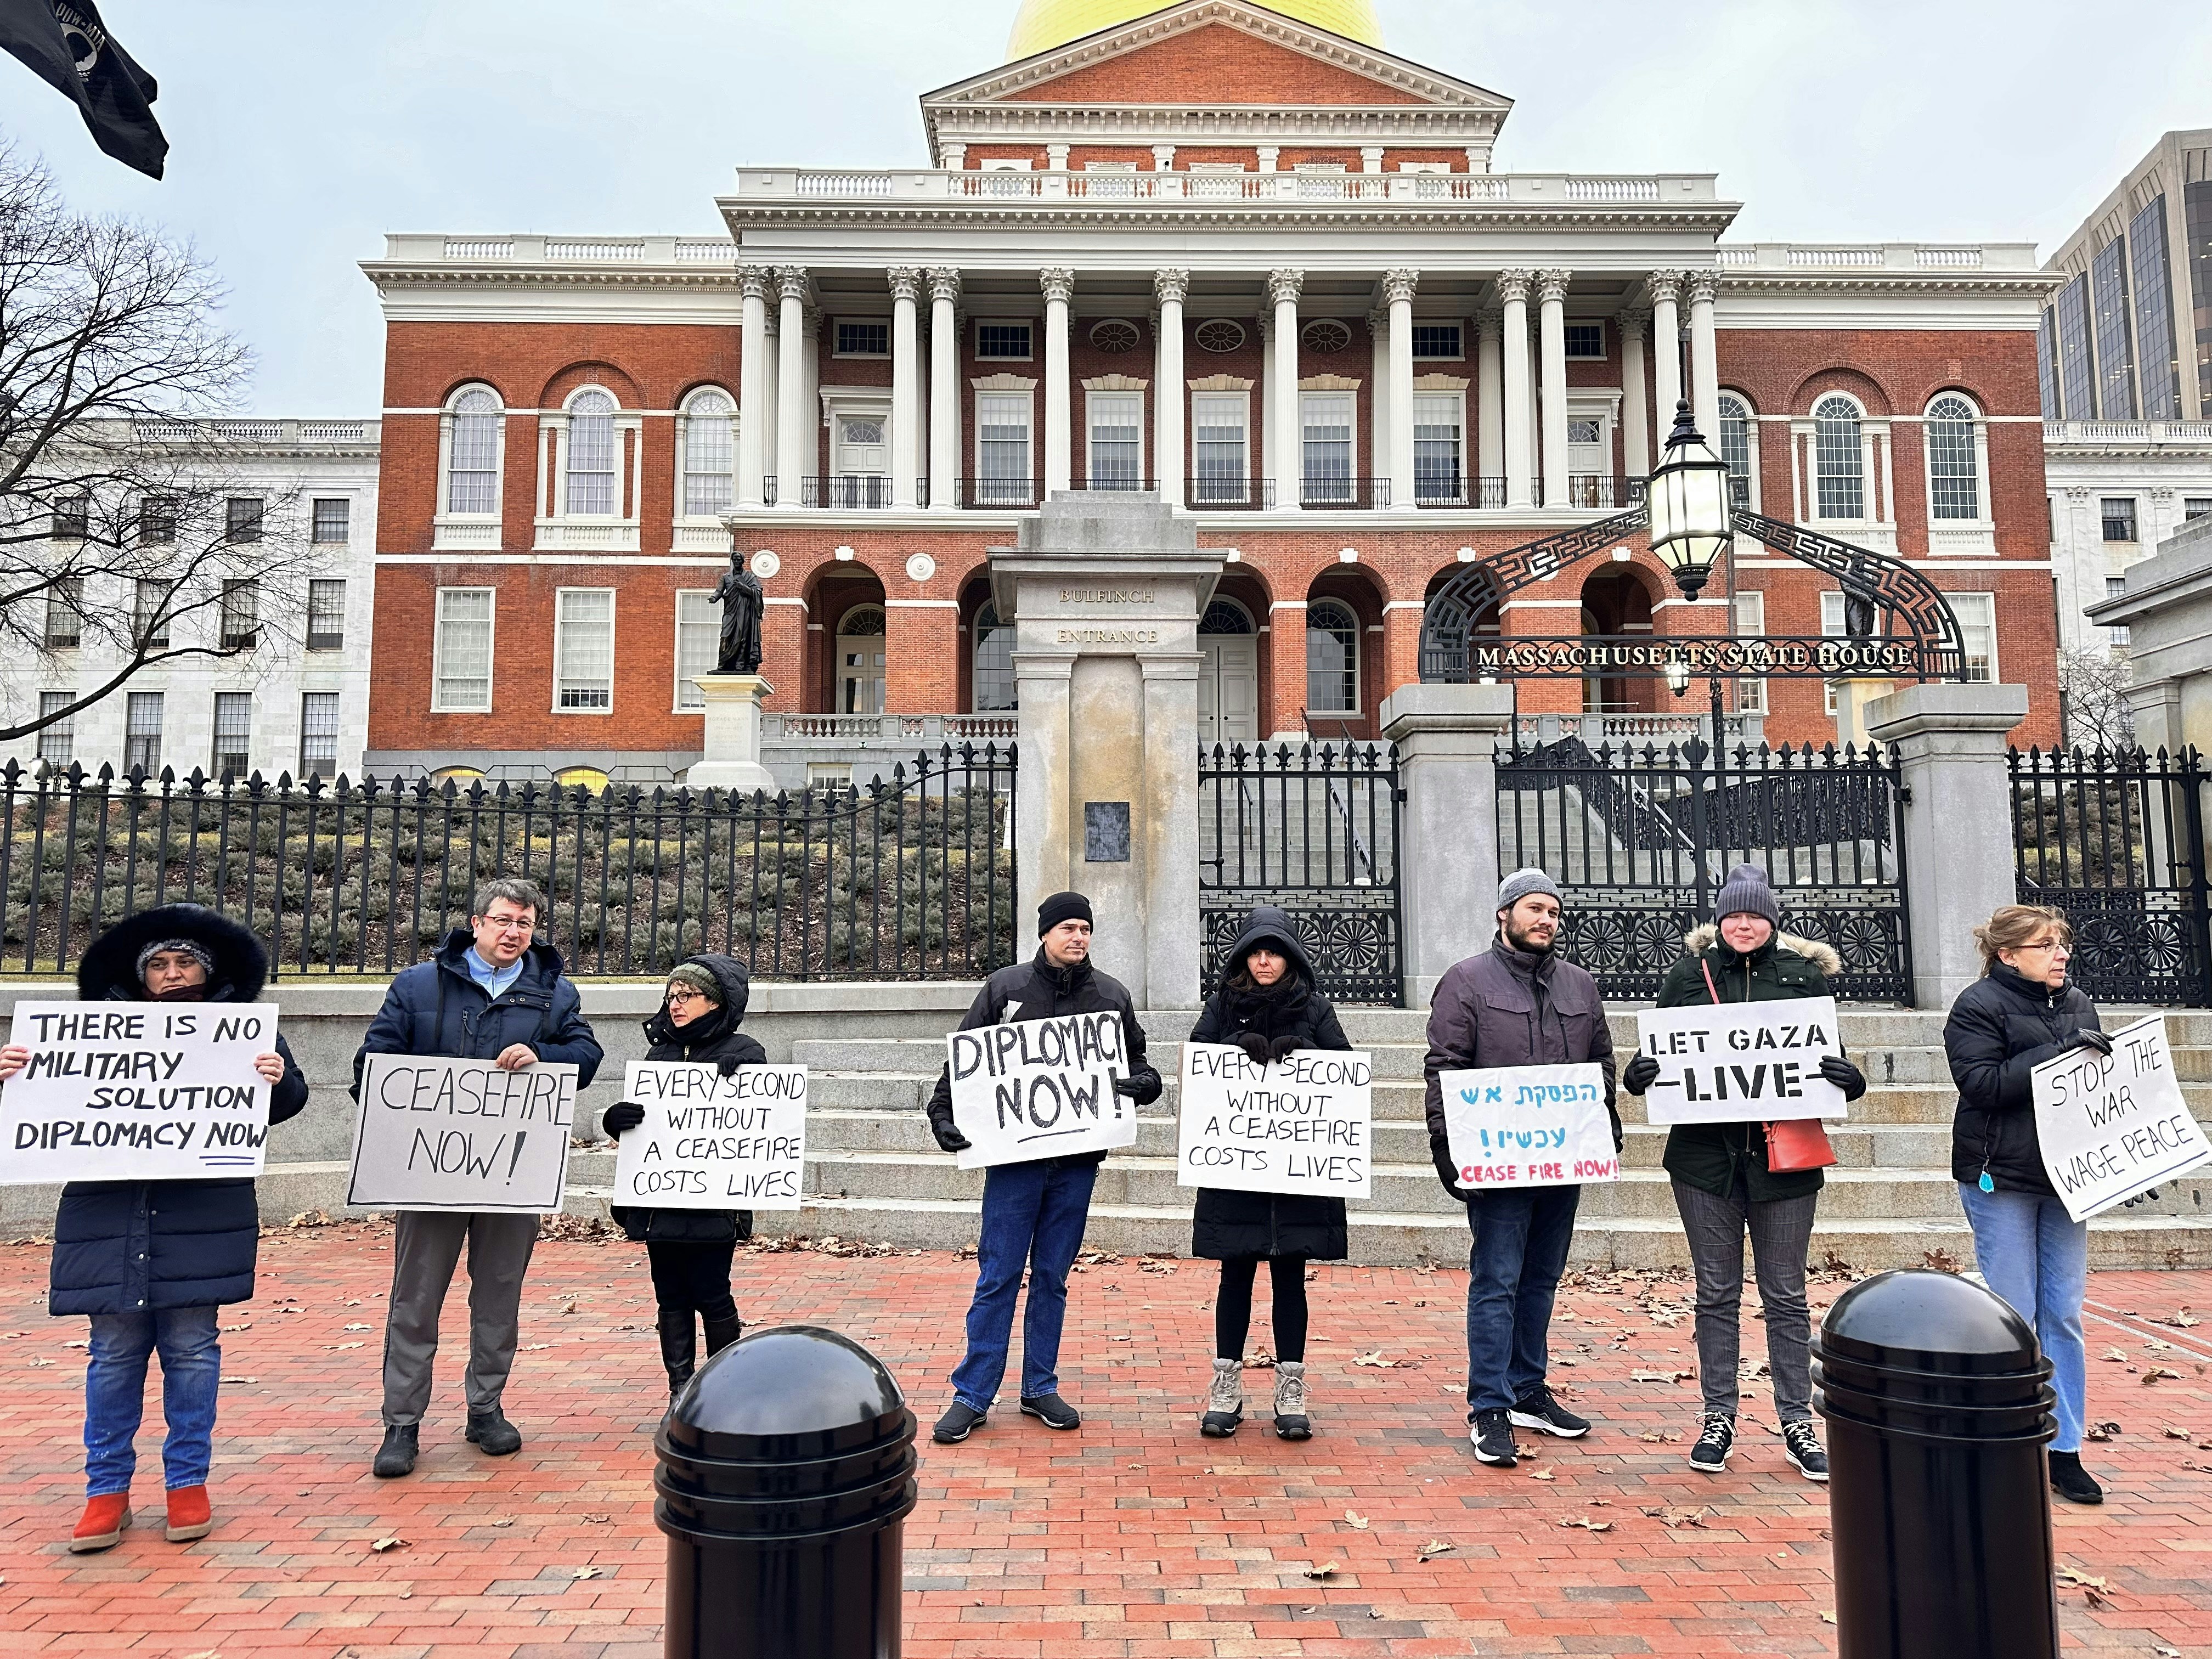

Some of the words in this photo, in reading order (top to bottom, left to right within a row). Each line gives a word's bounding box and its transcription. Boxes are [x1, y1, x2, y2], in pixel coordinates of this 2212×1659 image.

[55, 2, 82, 26] POW
[84, 22, 105, 52] MIA
[1059, 590, 1154, 603] BULFINCH
[1058, 630, 1158, 642] ENTRANCE
[1477, 647, 1716, 665] MASSACHUSETTS
[1727, 647, 1806, 665] STATE
[1817, 647, 1912, 665] HOUSE
[30, 1013, 144, 1042] THERE
[165, 1015, 197, 1038] IS
[212, 1018, 261, 1042] NO
[1649, 1030, 1709, 1055] LET
[1728, 1024, 1828, 1050] GAZA
[952, 1013, 1123, 1082] DIPLOMACY
[26, 1051, 184, 1082] MILITARY
[1280, 1057, 1371, 1086] SECOND
[2052, 1054, 2114, 1107] STOP
[2125, 1036, 2162, 1078] THE
[86, 1086, 255, 1110] SOLUTION
[381, 1068, 578, 1126] CEASEFIRE
[635, 1069, 720, 1102] EVERY
[724, 1071, 805, 1099] SECOND
[996, 1066, 1122, 1129] NOW!
[1460, 1085, 1502, 1105] אש
[1515, 1084, 1596, 1108] הפסקת
[1227, 1090, 1332, 1116] WITHOUT
[2085, 1085, 2137, 1128] WAR
[668, 1107, 771, 1130] WITHOUT
[1204, 1116, 1220, 1136] A
[1229, 1115, 1363, 1147] CEASEFIRE
[15, 1121, 195, 1150] DIPLOMACY
[204, 1122, 268, 1149] NOW
[644, 1141, 662, 1163] A
[676, 1137, 801, 1161] CEASEFIRE
[408, 1127, 527, 1186] NOW!
[1189, 1146, 1268, 1170] COSTS
[1288, 1154, 1363, 1182] LIVES
[2055, 1144, 2125, 1194] WAGE
[2121, 1114, 2194, 1165] PEACE
[634, 1170, 707, 1195] COSTS
[727, 1171, 797, 1198] LIVES
[1461, 1165, 1517, 1182] CEASE
[1528, 1162, 1564, 1180] FIRE
[1573, 1159, 1618, 1180] NOW!
